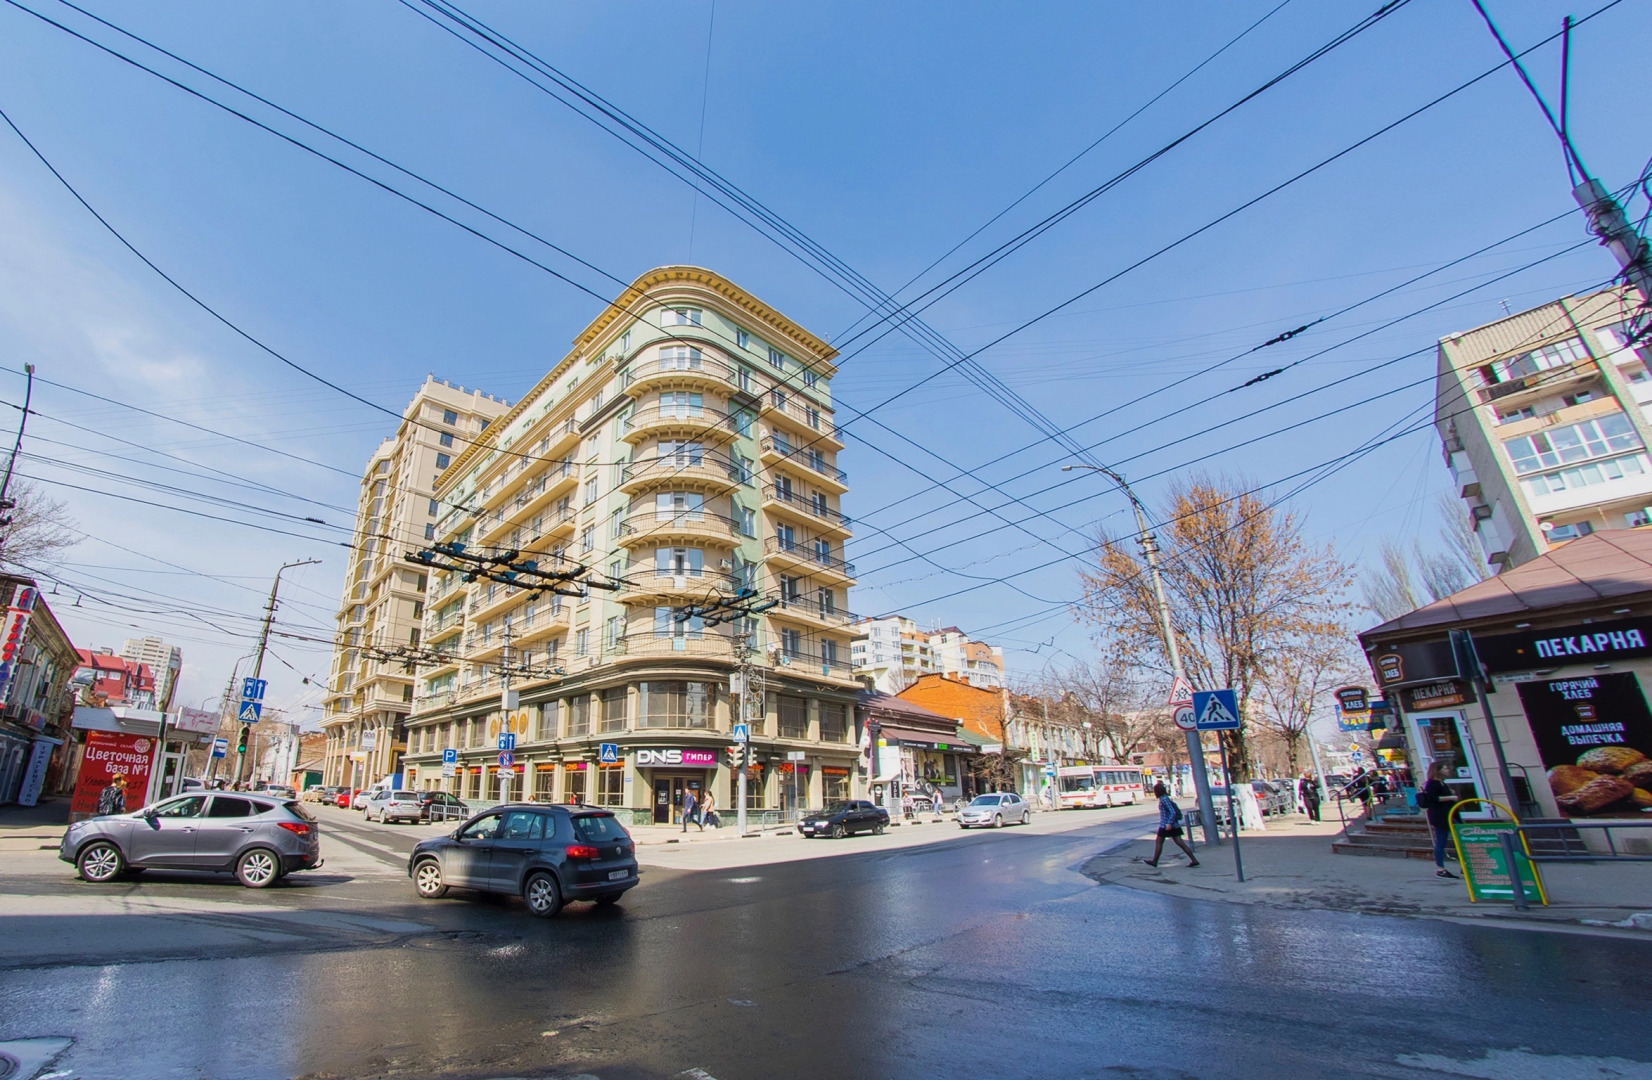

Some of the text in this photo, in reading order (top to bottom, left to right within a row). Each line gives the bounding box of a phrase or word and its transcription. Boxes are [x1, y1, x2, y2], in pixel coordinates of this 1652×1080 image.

[1534, 629, 1647, 658] ПЕКАРНЯ
[1384, 668, 1400, 679] ХЛЕБ
[1413, 682, 1457, 700] ПЕКАРНЯ
[1550, 677, 1599, 692] ГОРЯЧИЙ
[1562, 689, 1593, 700] ХЛЕБ
[1344, 700, 1364, 710] ХЛЕБ
[1180, 712, 1195, 723] 40
[1342, 716, 1382, 726] ОДЕЖД
[1561, 721, 1625, 736] ДОМАШНЯЯ
[1567, 733, 1625, 746] ВЫПЕЧКА
[85, 746, 149, 765] Цветочная
[636, 749, 713, 765] DNS ГИПЕР
[105, 761, 149, 776] база №1
